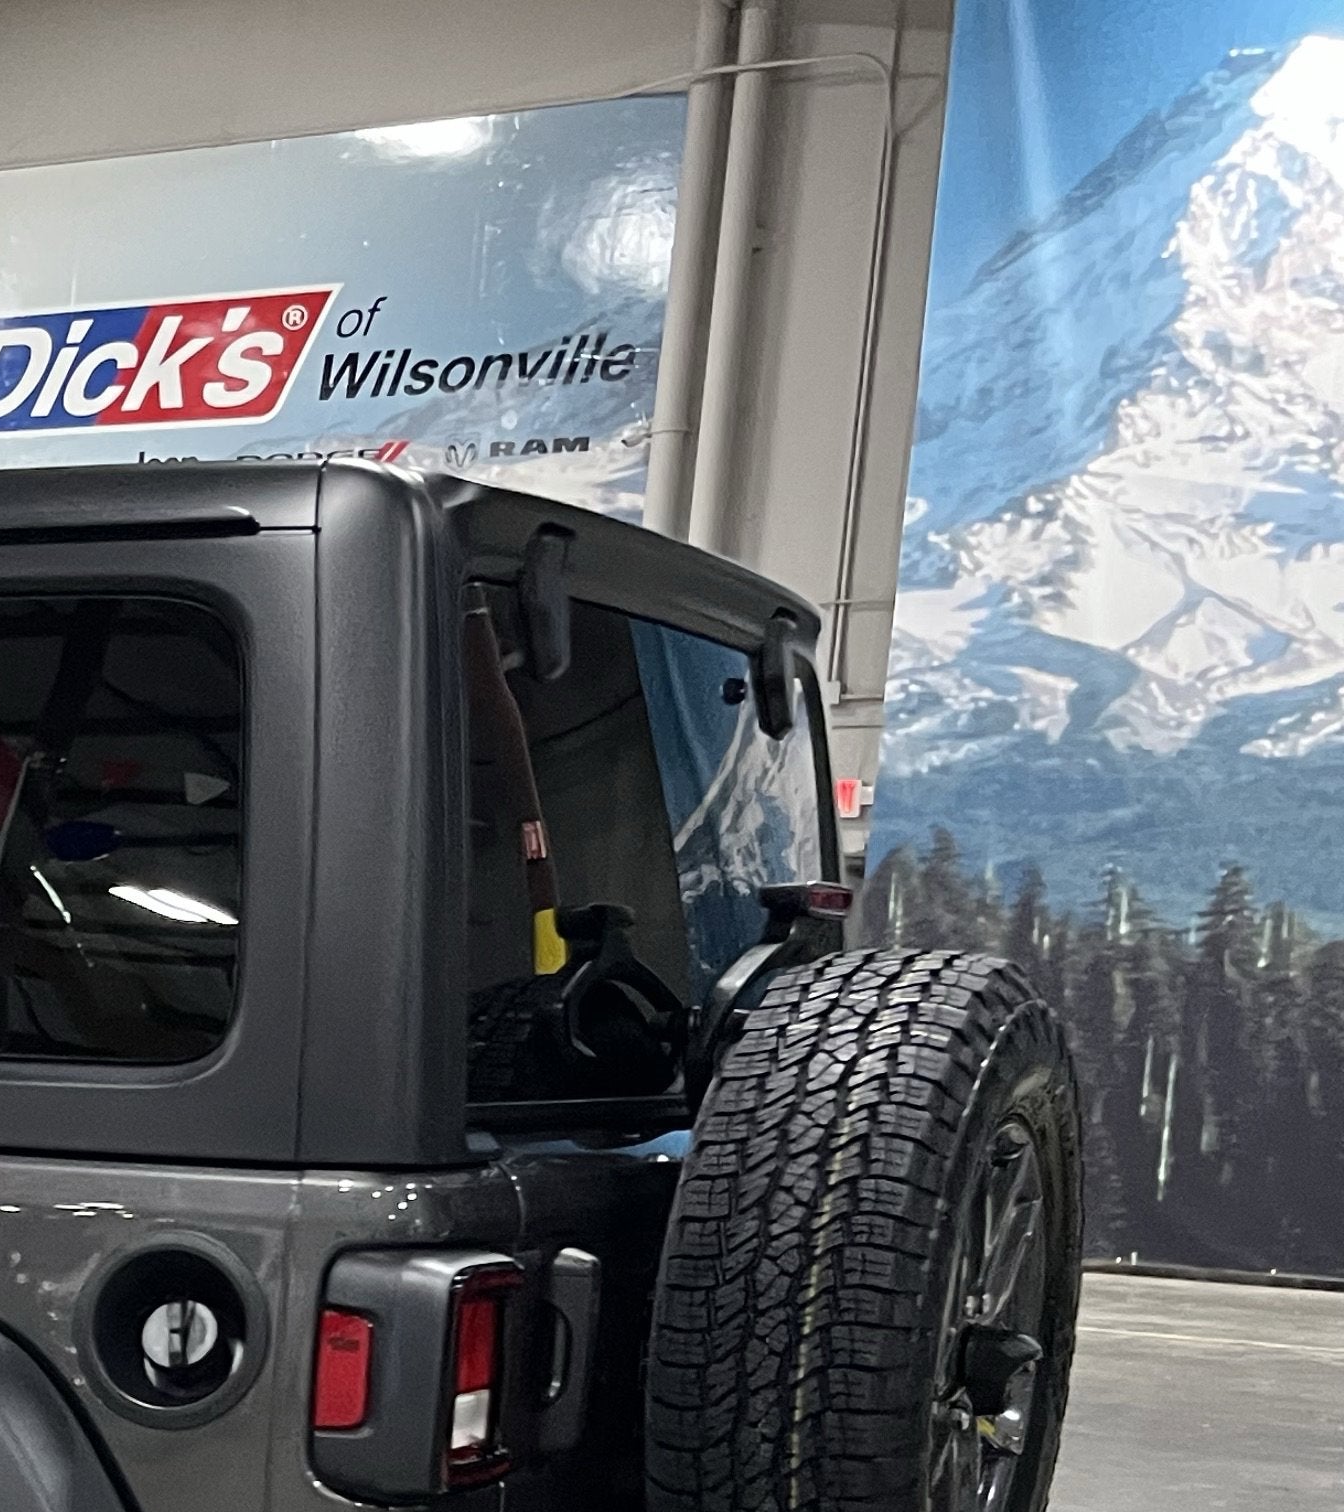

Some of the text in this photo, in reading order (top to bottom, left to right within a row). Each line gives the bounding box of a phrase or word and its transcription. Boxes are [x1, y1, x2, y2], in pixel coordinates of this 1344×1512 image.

[336, 296, 388, 338] of
[318, 332, 637, 401] Wilsonville
[489, 436, 590, 458] RAM
